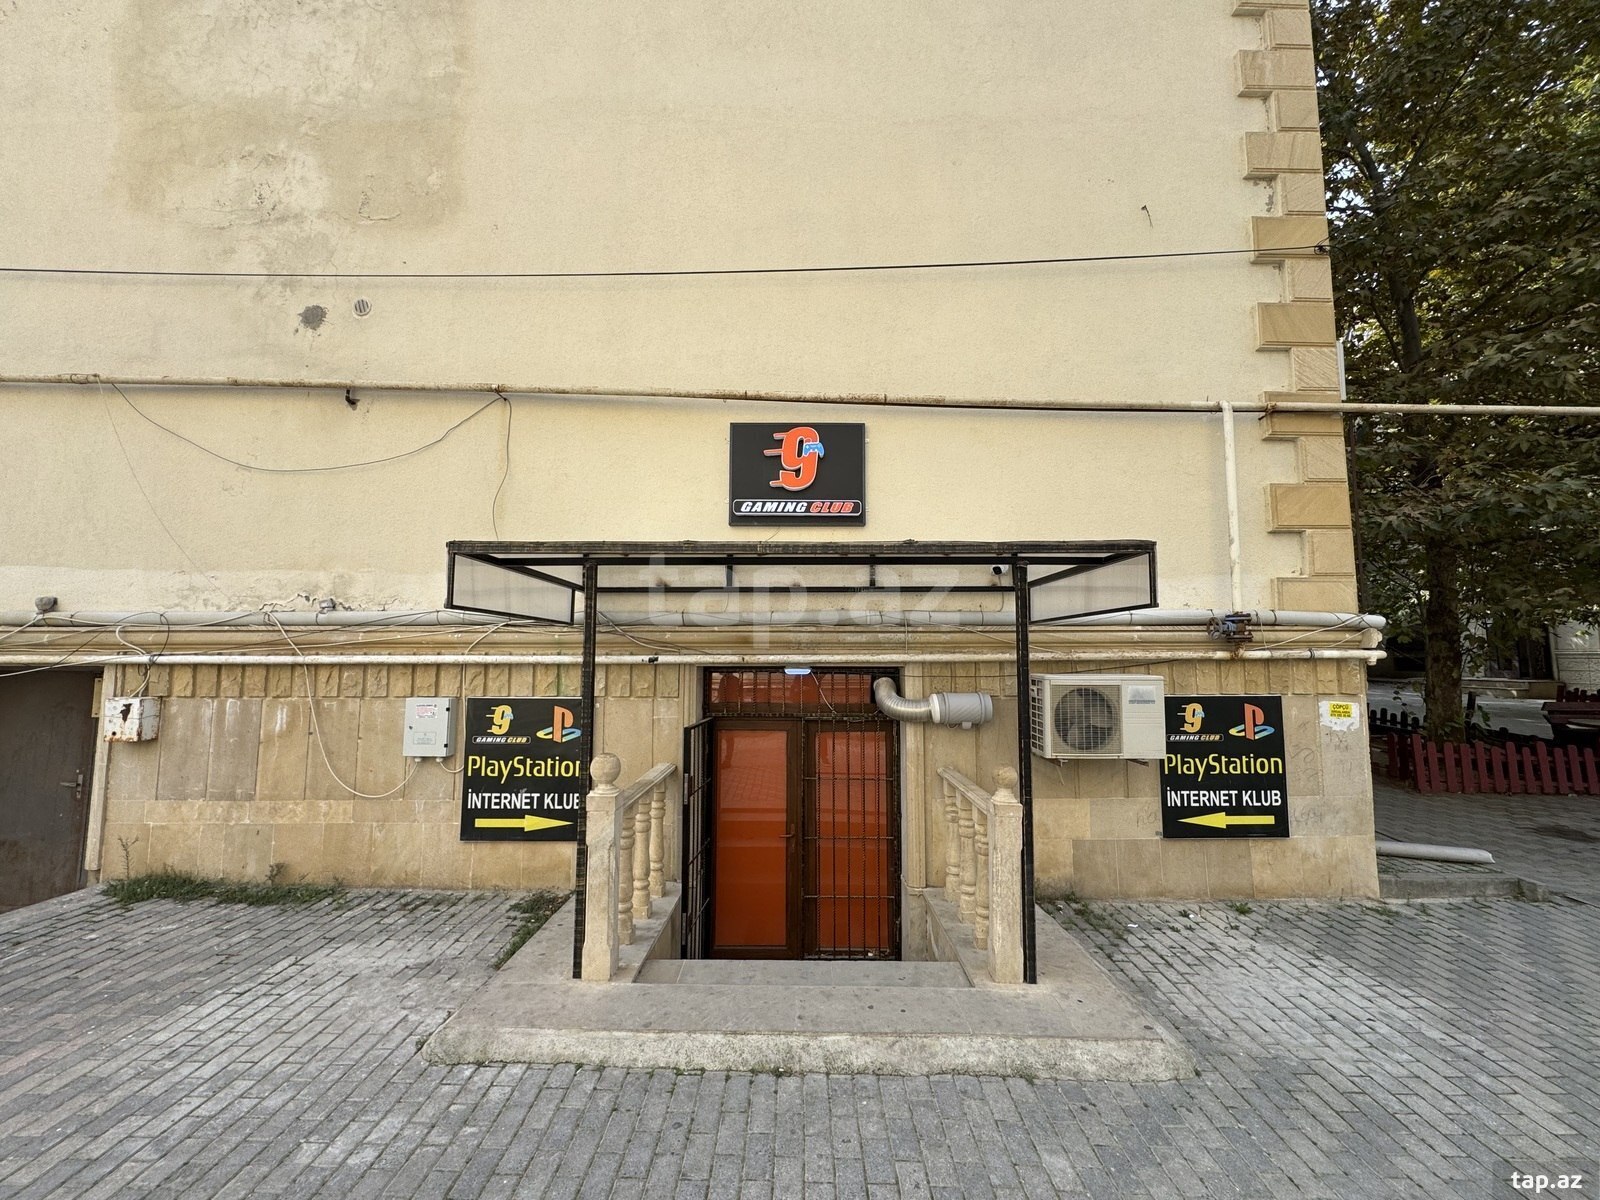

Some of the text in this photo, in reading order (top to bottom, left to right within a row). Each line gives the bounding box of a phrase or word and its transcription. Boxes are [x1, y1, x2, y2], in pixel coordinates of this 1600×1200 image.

[740, 501, 854, 513] GAMING CLUB
[1164, 753, 1283, 782] PlayStation
[467, 788, 540, 809] İNTERNET
[1167, 786, 1282, 807] İNTERNET KLUB
